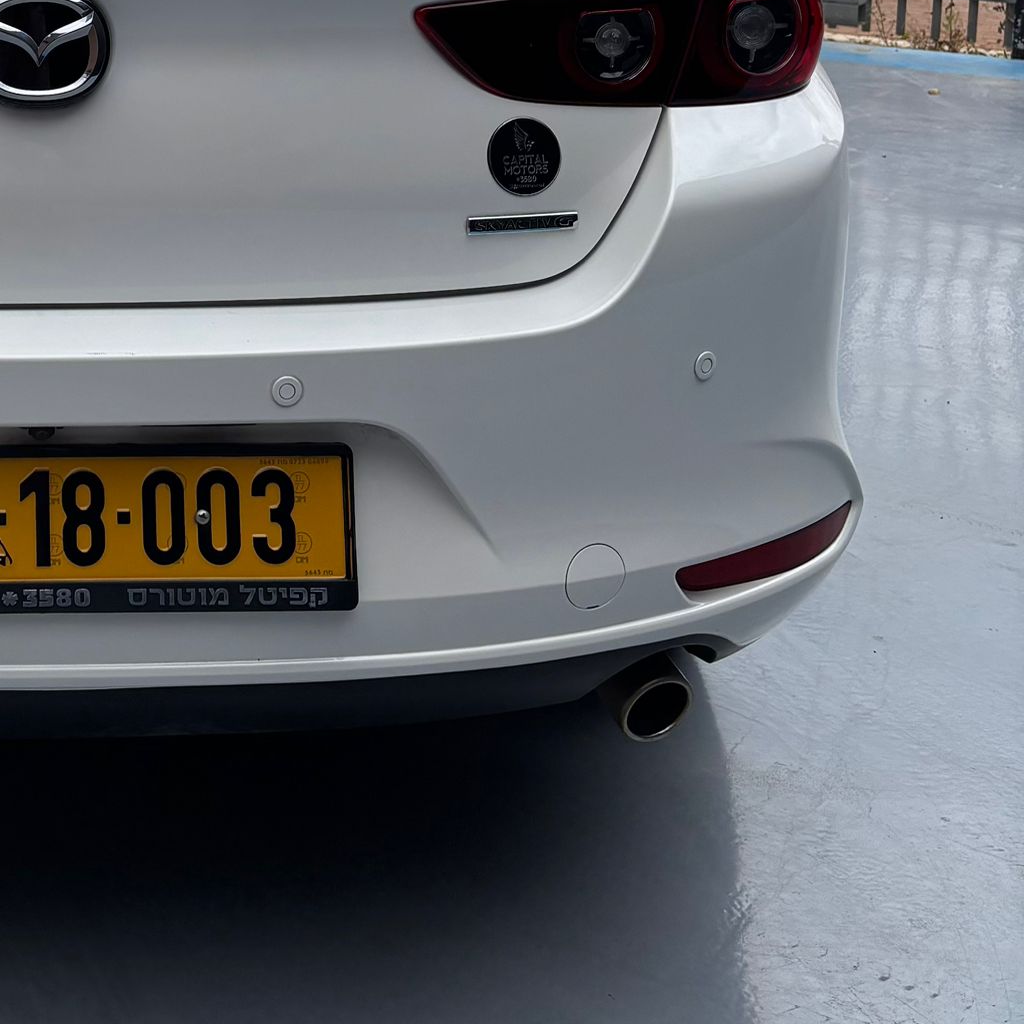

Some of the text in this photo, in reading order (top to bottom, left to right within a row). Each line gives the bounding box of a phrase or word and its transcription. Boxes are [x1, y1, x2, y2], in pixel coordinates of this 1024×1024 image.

[503, 154, 549, 166] CAPITAL
[504, 165, 549, 176] MOTORS
[127, 584, 329, 608] קפיטל מוטורס
